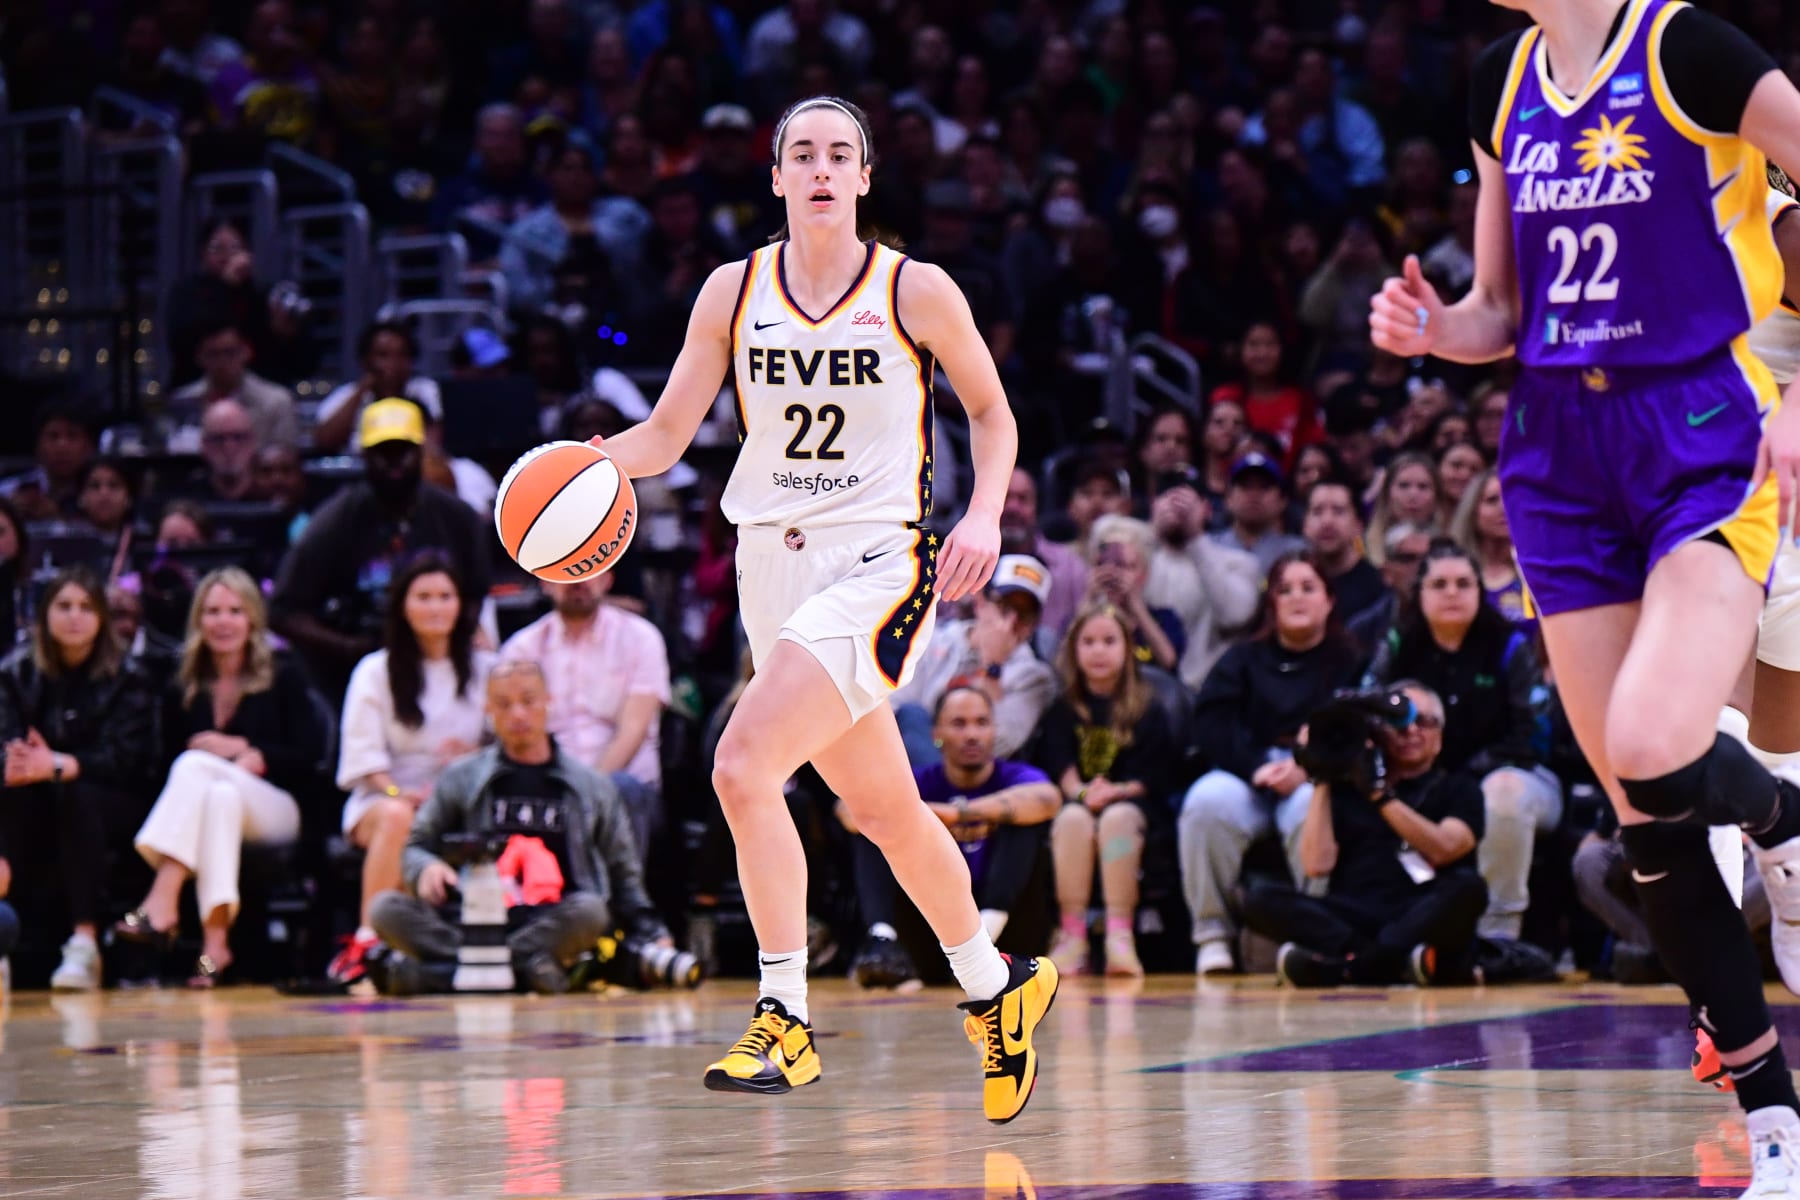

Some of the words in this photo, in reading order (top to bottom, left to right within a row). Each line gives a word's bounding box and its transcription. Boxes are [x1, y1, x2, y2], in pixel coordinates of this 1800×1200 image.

[1547, 222, 1620, 304] 22
[851, 310, 885, 329] Lilly
[749, 347, 883, 386] FEVER
[784, 403, 845, 460] 22
[562, 508, 633, 577] Wilson
